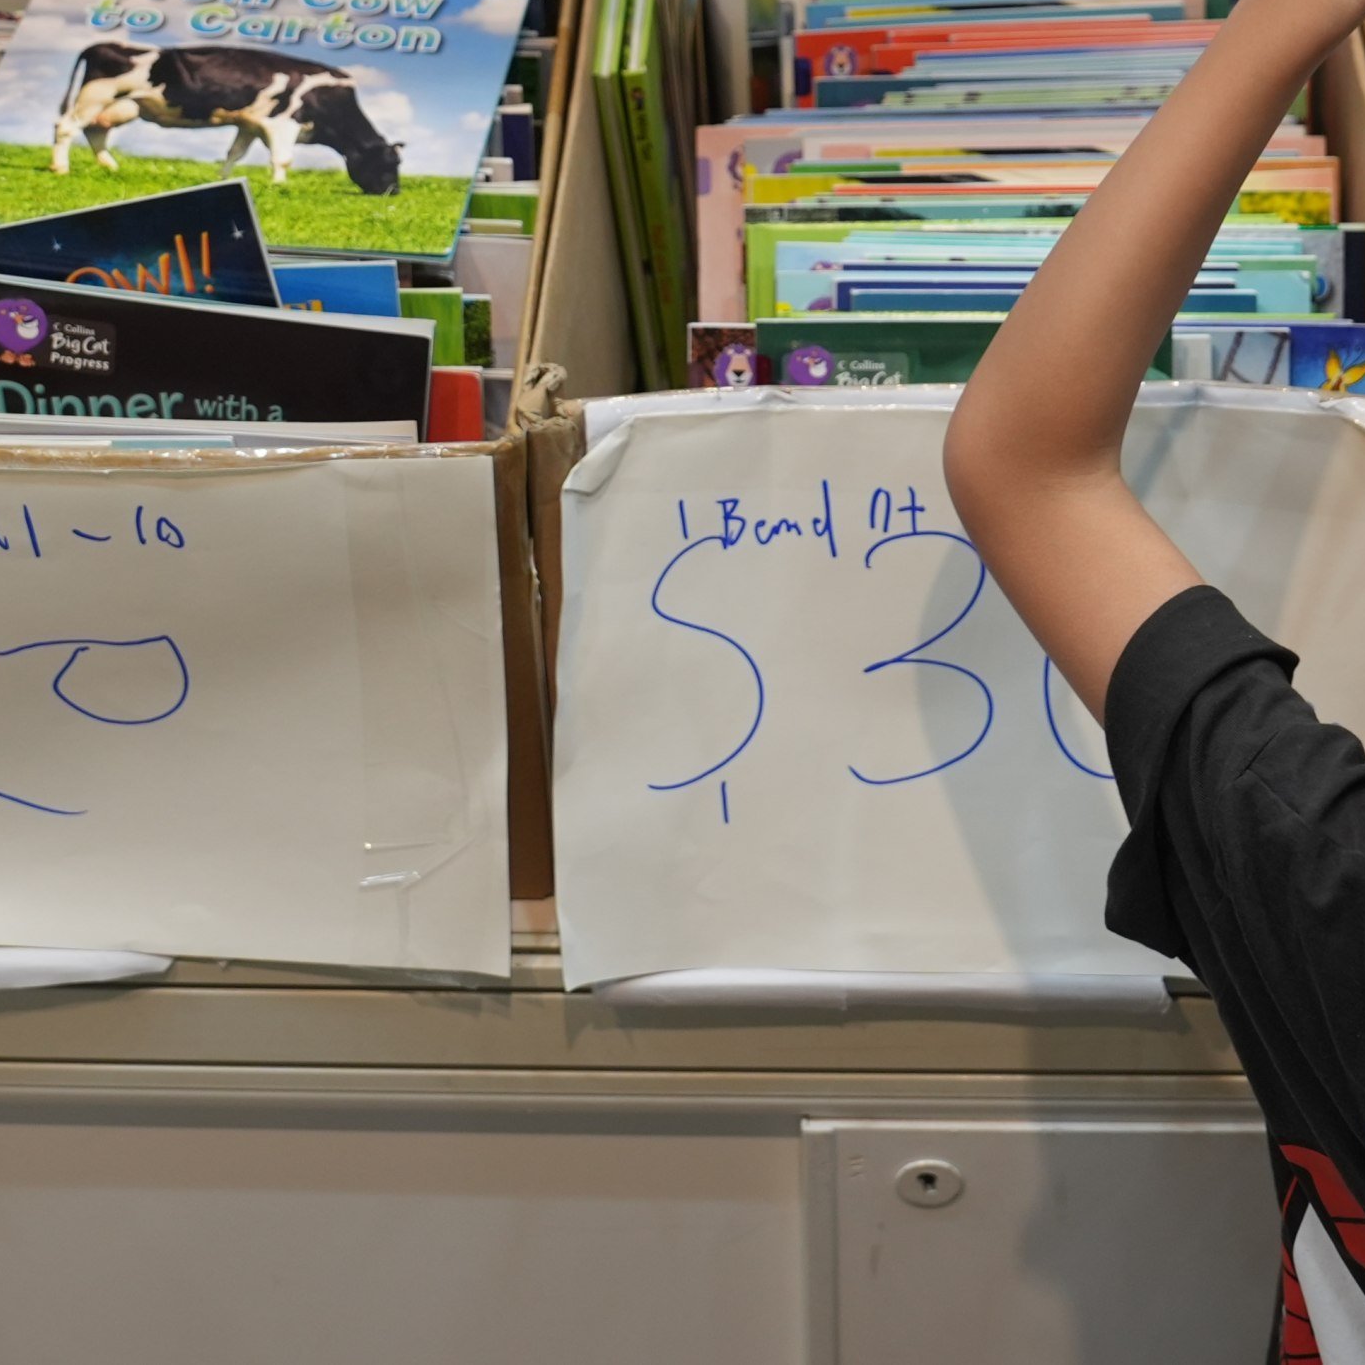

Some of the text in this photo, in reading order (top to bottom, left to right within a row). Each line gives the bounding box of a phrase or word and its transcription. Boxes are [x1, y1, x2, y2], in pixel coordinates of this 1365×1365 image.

[87, 0, 445, 55] to Carton
[63, 322, 96, 336] Collins
[50, 331, 111, 355] Big Cat
[49, 350, 111, 372] Progress
[848, 359, 887, 373] Collins
[193, 395, 259, 422] with
[267, 403, 285, 422] a
[719, 480, 838, 559] Band
